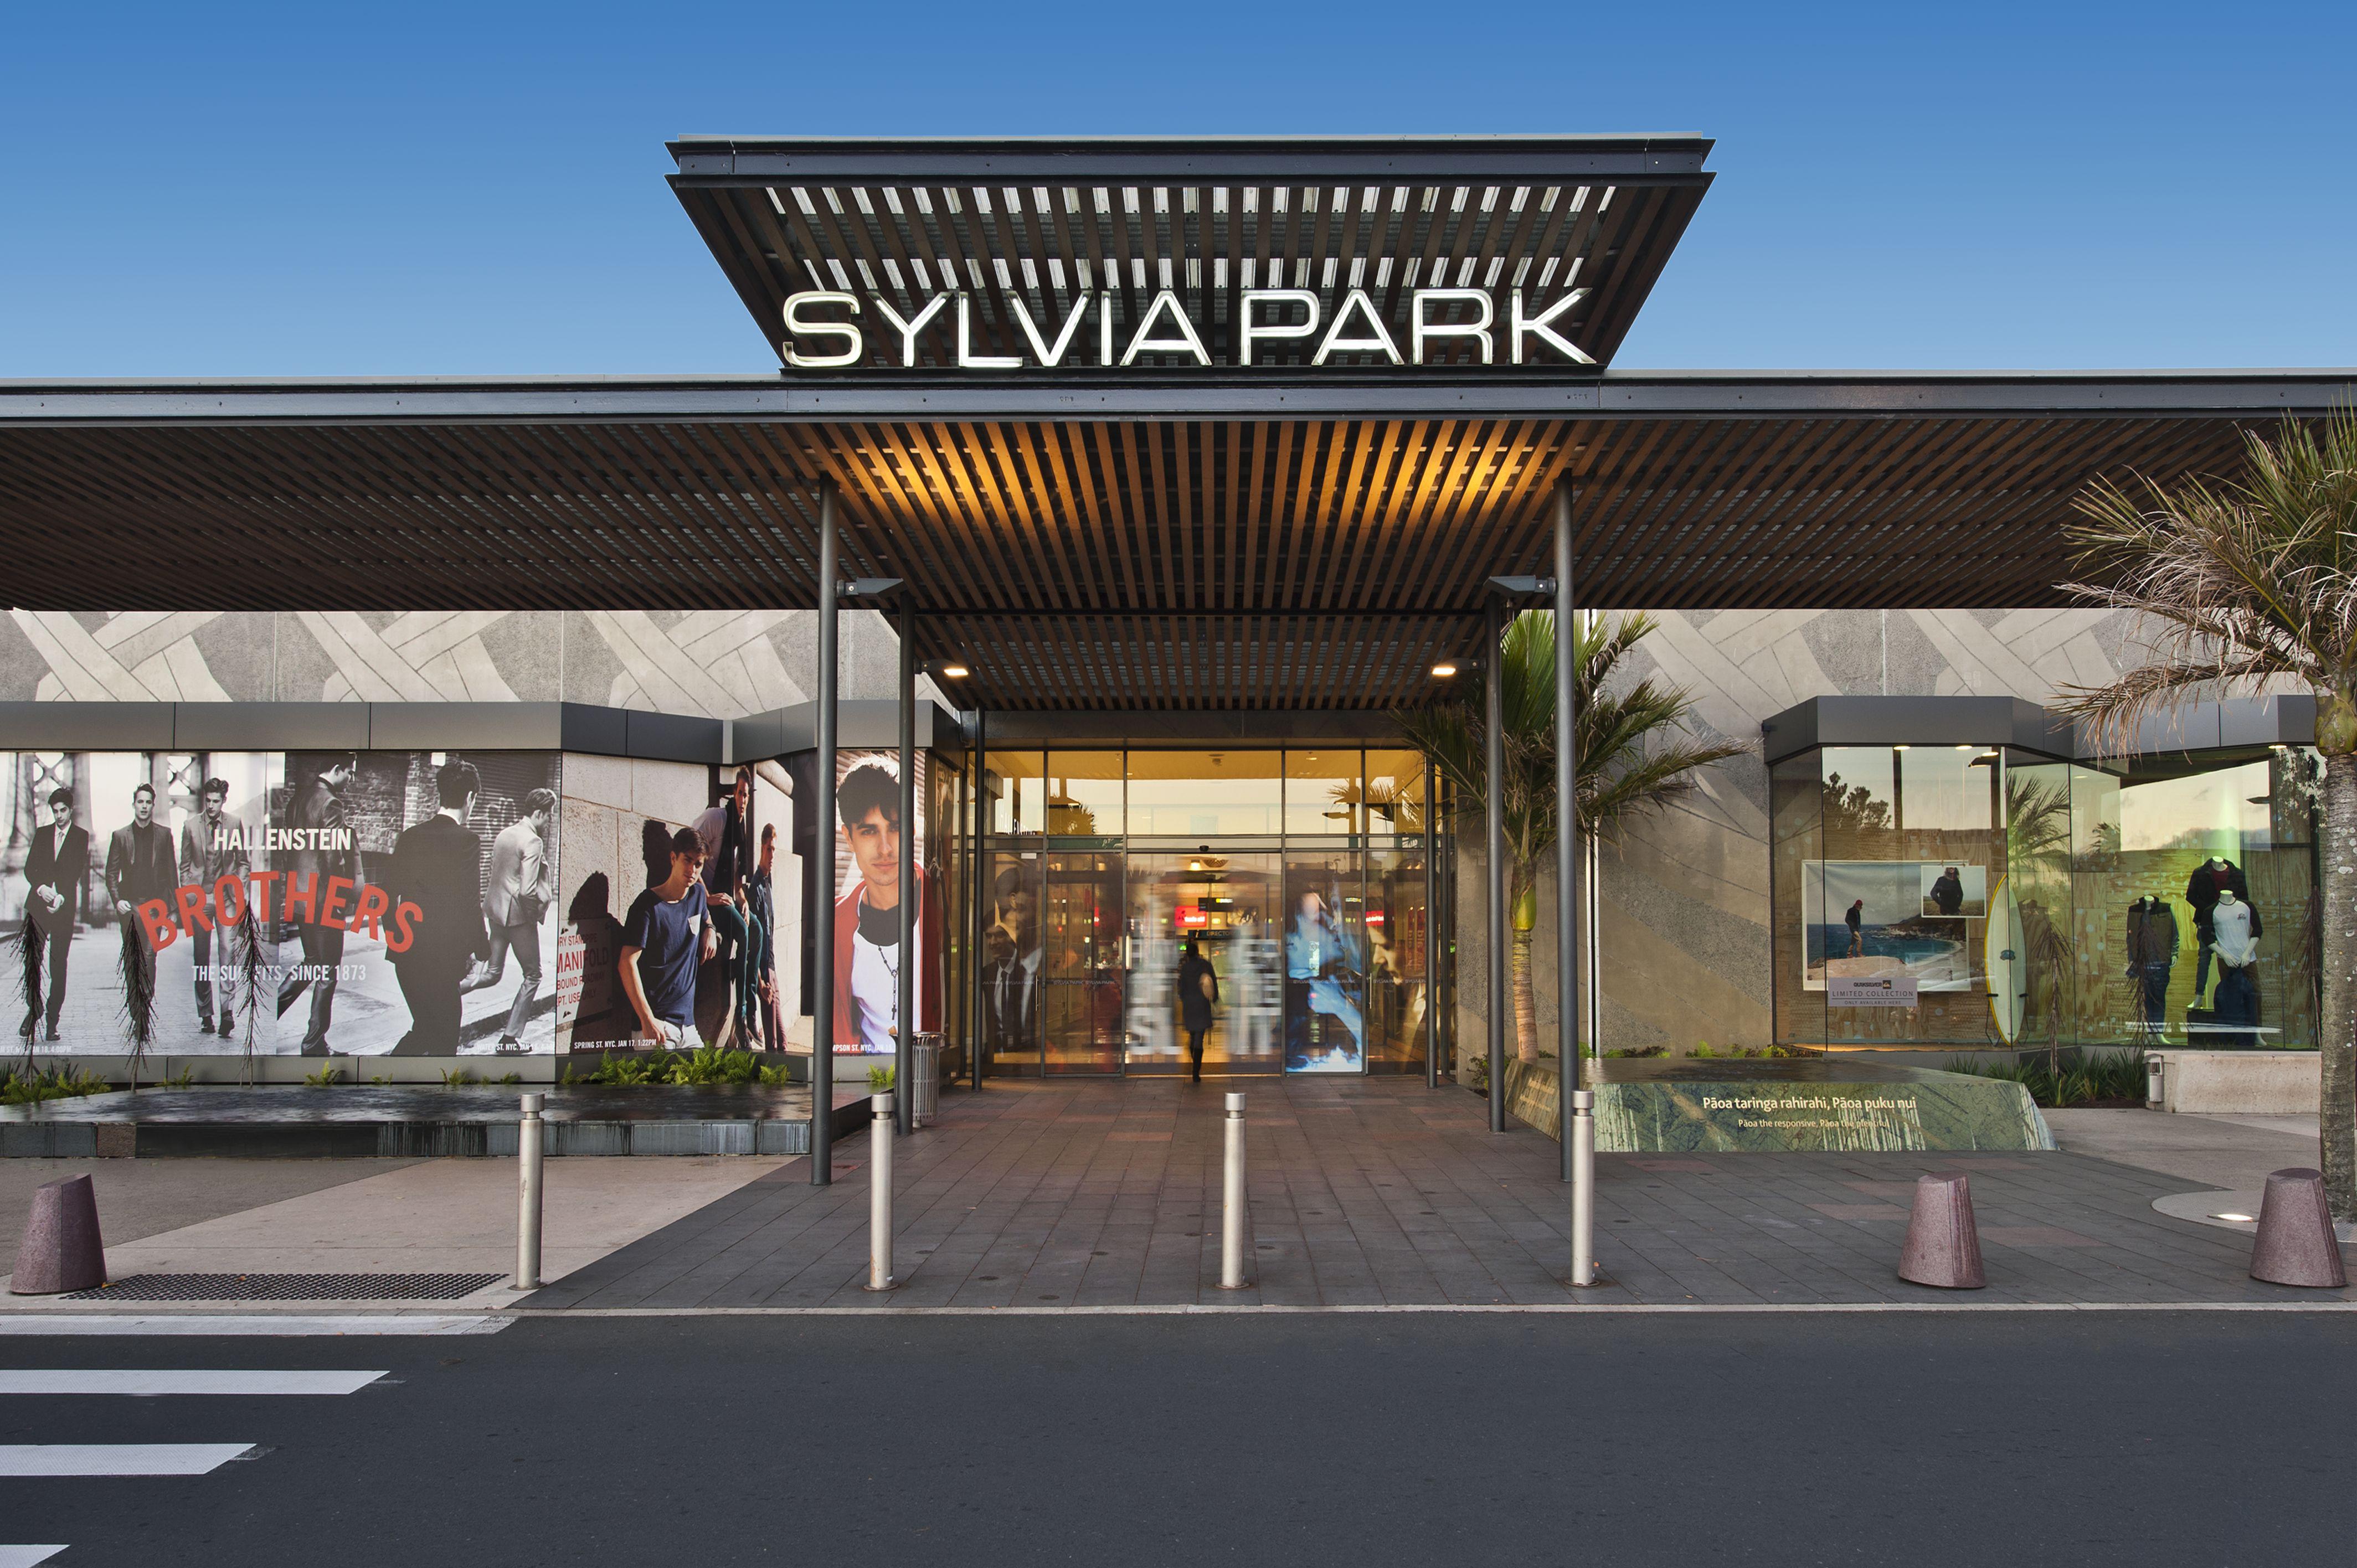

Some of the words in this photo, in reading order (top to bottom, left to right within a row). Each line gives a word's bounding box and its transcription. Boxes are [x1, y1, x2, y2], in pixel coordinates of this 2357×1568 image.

[783, 290, 1213, 368] SYLVIA
[1241, 287, 1597, 367] PARK
[214, 828, 351, 851] HALLENSTEIN
[138, 871, 423, 953] BROTHERS
[558, 935, 567, 947] RY
[557, 947, 609, 973] MANIFOLD
[192, 965, 216, 981] THE
[290, 965, 330, 981] SINCE
[334, 965, 366, 981] 1873
[569, 992, 580, 1004] USE
[574, 1041, 594, 1049] SPRING
[1703, 1097, 1732, 1109] Pāoa
[1734, 1096, 1778, 1112] taringa
[1780, 1096, 1830, 1111] rahirahi,
[1832, 1097, 1862, 1108] Pāoa
[1864, 1096, 1895, 1112] puku
[1897, 1096, 1917, 1109] nui
[1738, 1119, 1758, 1127] Pāoa
[1759, 1119, 1773, 1127] the
[1774, 1118, 1819, 1129] responsive,
[1820, 1119, 1839, 1127] Pāoa
[1841, 1119, 1855, 1127] the
